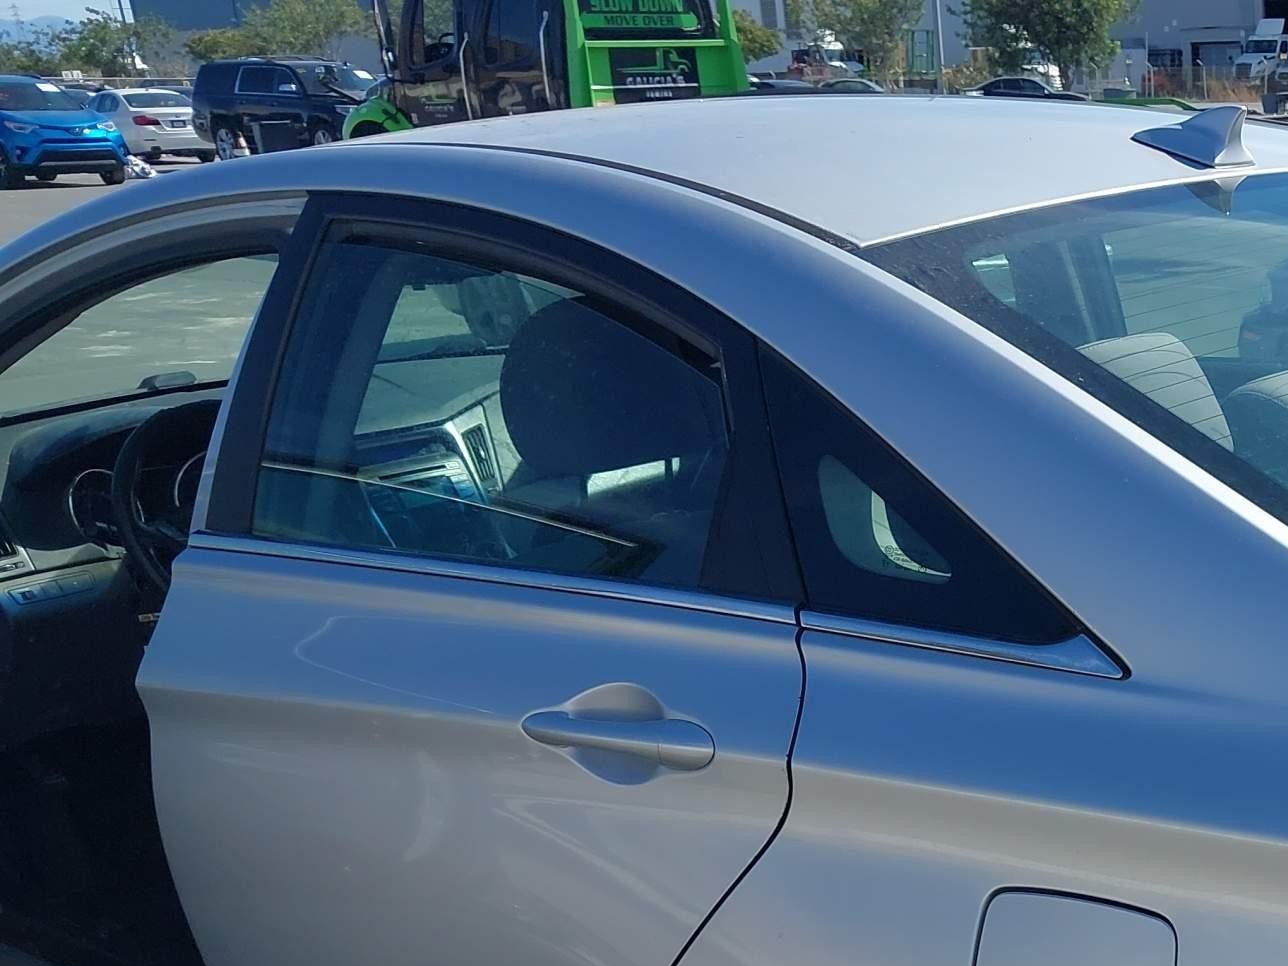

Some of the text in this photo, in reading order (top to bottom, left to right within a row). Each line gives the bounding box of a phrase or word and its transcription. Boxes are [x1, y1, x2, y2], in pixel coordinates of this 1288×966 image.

[591, 0, 683, 12] SLOW DOWN
[604, 15, 674, 26] MOVE OVER
